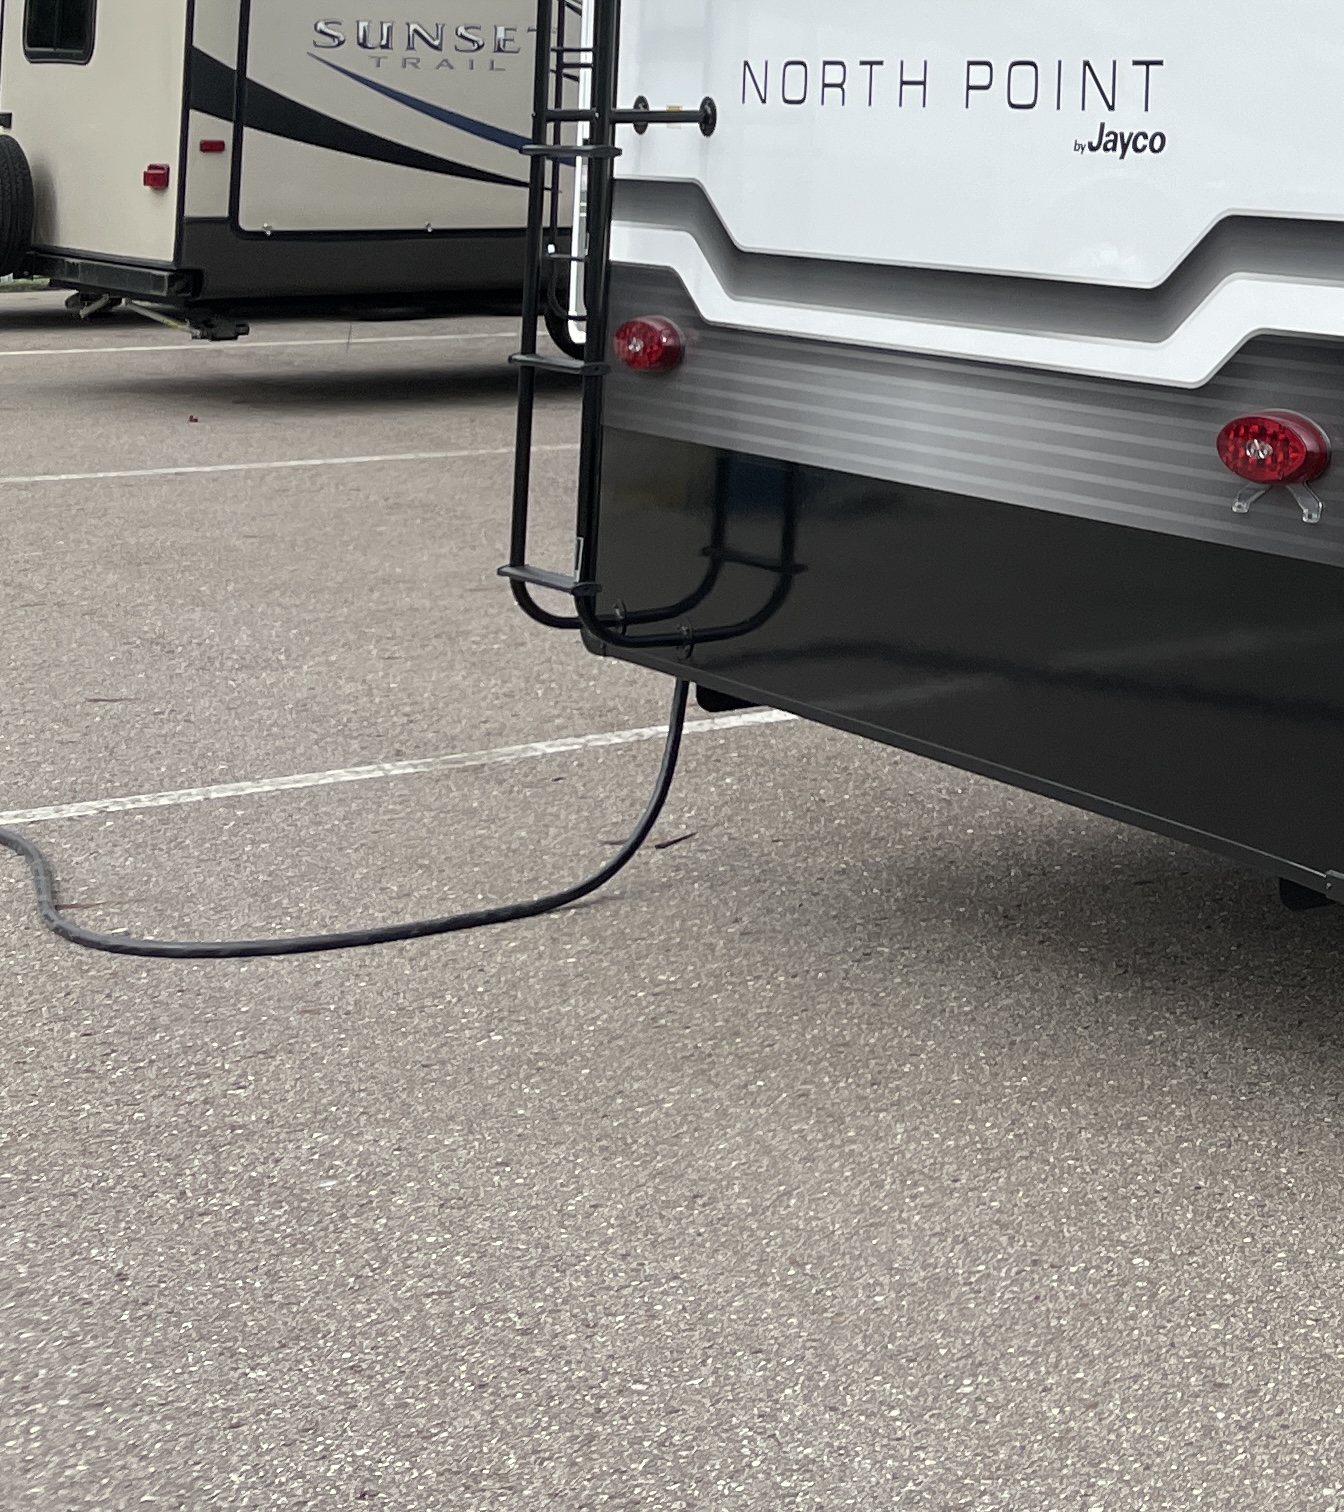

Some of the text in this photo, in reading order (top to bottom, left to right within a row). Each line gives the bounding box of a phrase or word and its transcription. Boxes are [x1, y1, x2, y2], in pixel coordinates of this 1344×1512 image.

[368, 55, 507, 71] TRAIL
[741, 59, 1165, 112] NORTH POINT
[1073, 122, 1167, 159] by Jayco
